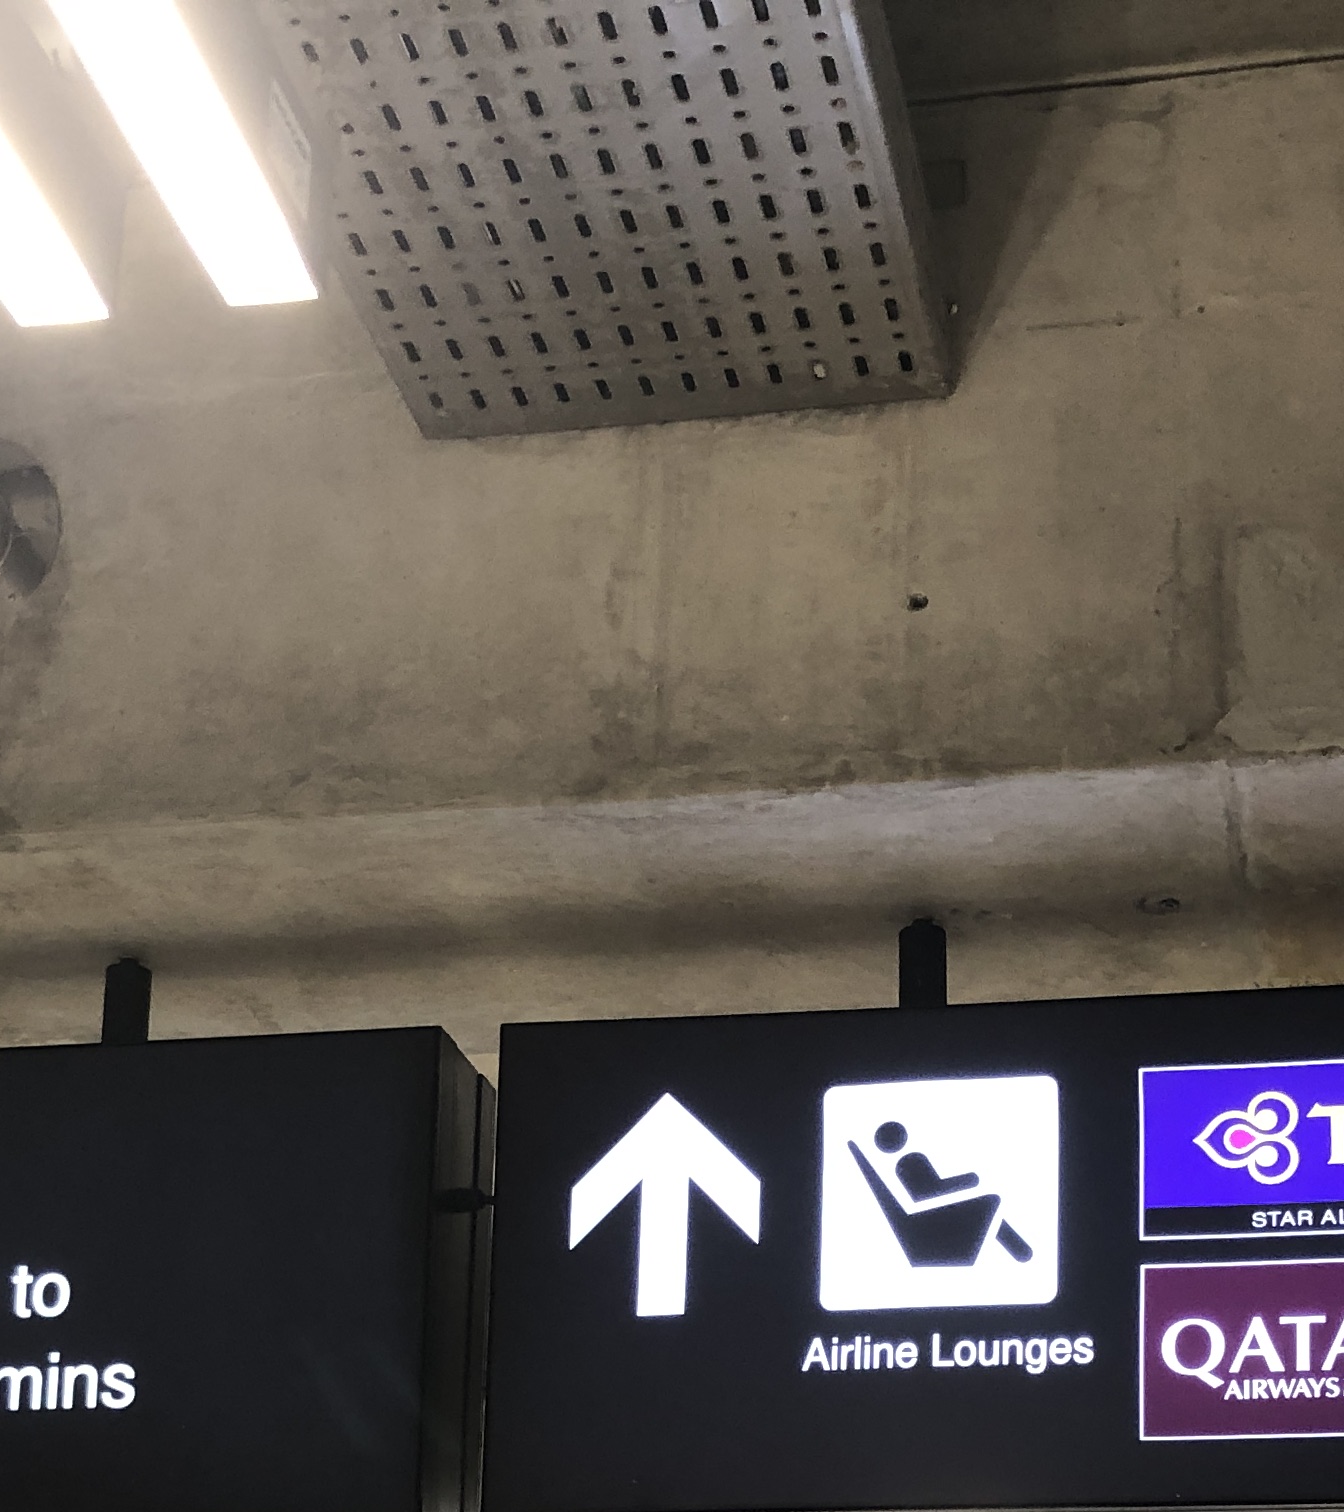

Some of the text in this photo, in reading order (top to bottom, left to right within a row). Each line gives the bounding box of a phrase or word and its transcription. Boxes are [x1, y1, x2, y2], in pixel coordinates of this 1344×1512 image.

[1252, 1209, 1313, 1228] STAR
[11, 1264, 71, 1319] to
[801, 1332, 1095, 1375] Airline Lounges
[1224, 1376, 1341, 1400] AIRWAYS
